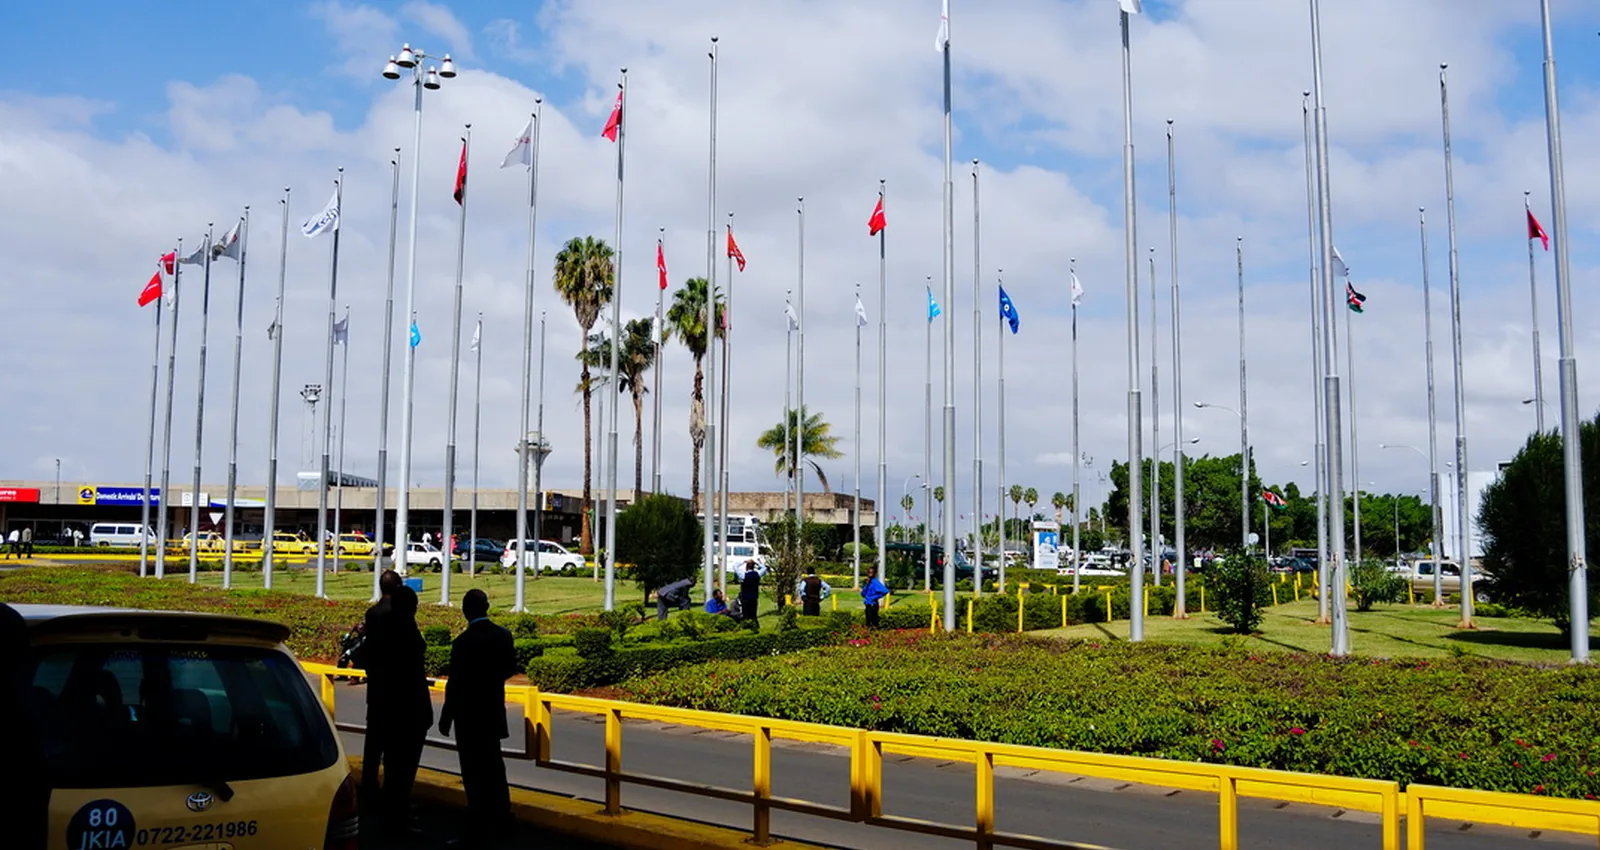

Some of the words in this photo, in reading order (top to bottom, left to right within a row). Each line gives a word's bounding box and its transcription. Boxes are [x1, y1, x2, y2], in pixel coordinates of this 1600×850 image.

[96, 492, 116, 500] Domestic
[89, 807, 117, 827] 80
[77, 830, 126, 850] JKIA
[136, 821, 257, 846] 0722-221986
